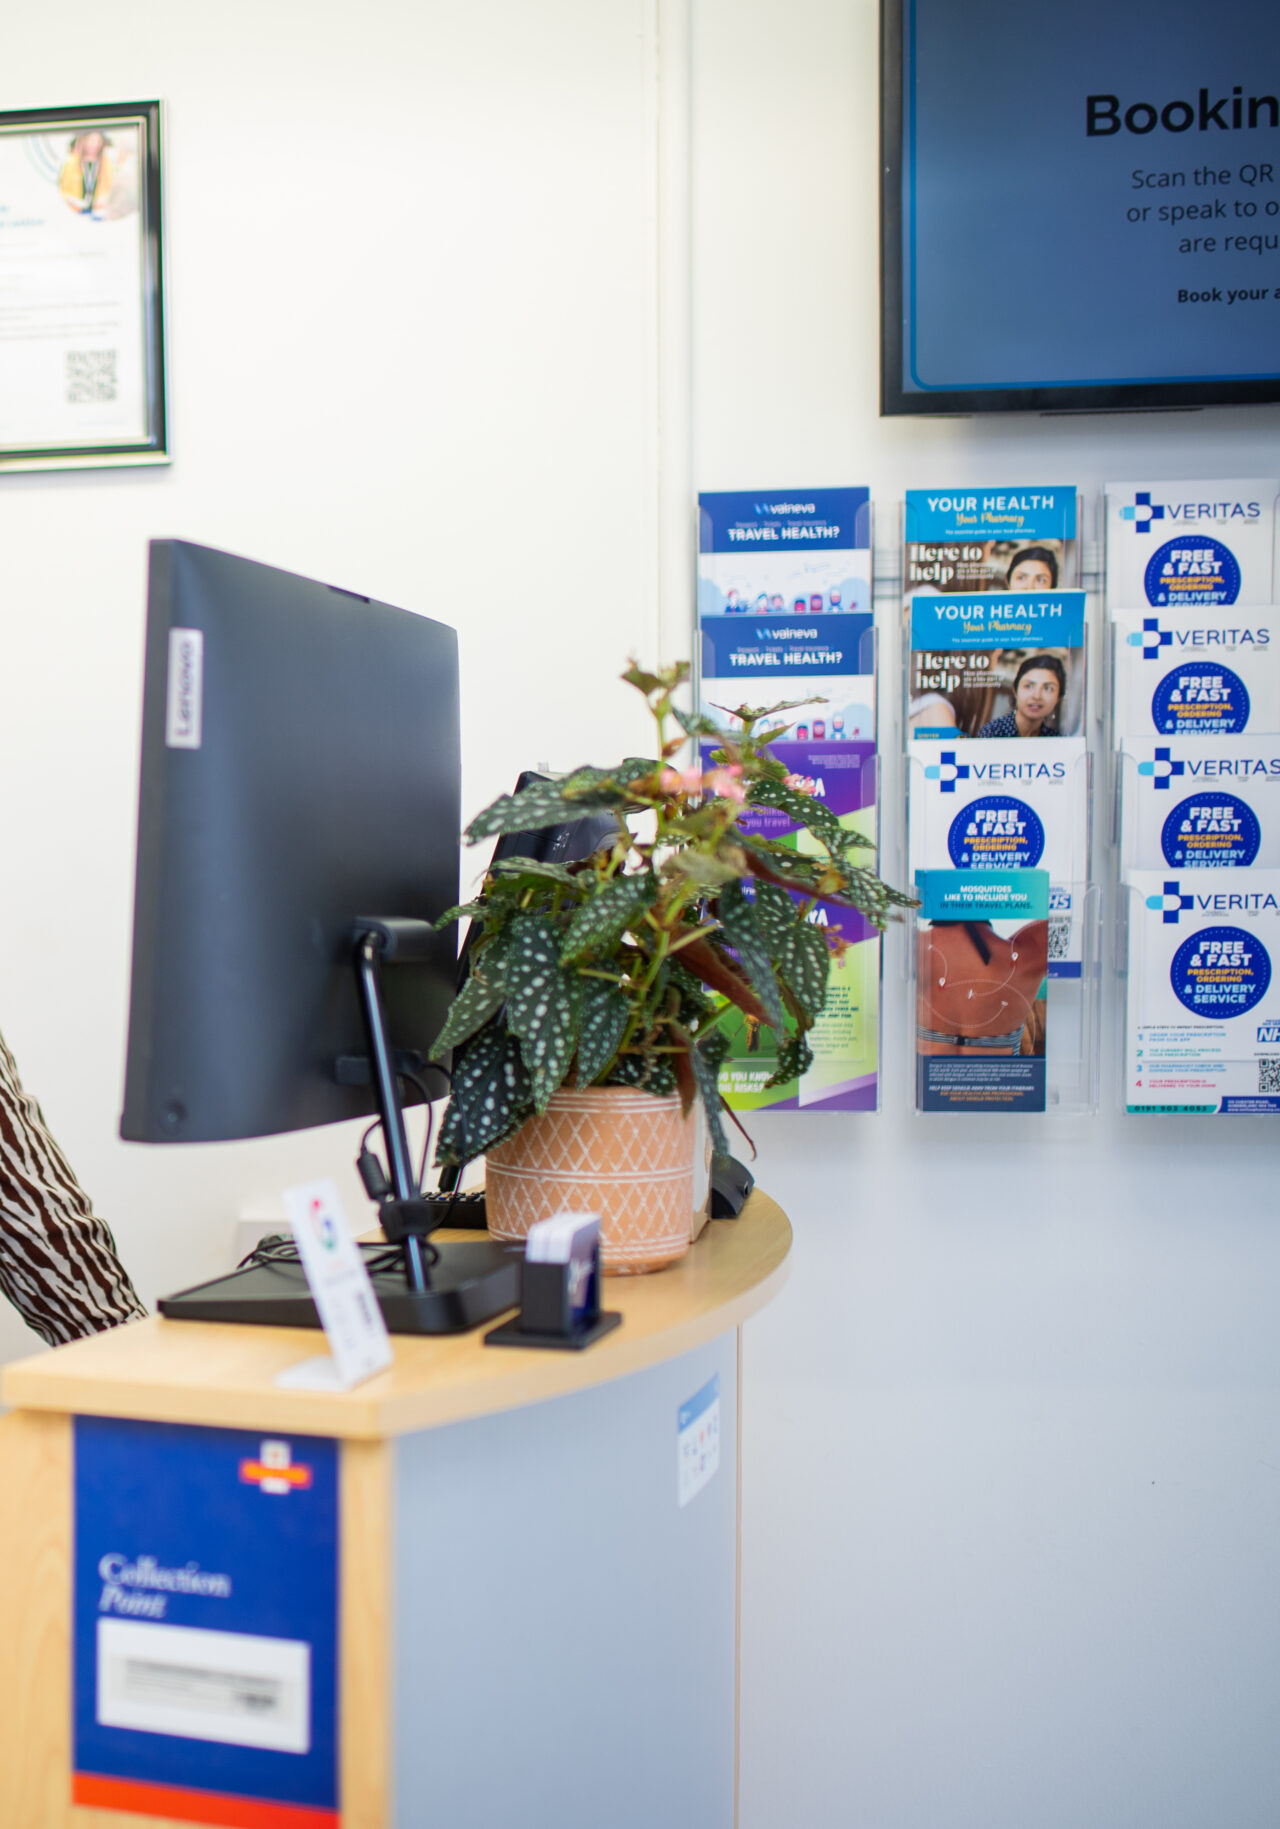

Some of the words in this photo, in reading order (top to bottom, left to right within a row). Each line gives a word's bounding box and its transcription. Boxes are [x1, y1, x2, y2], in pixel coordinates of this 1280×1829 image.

[1086, 86, 1280, 136] Bookin
[1131, 169, 1186, 189] Scan
[1194, 165, 1232, 186] the
[1239, 163, 1275, 188] QR
[1127, 207, 1152, 223] or
[1158, 199, 1226, 226] speak
[1234, 200, 1257, 218] to
[1178, 237, 1218, 254] are
[1224, 234, 1279, 256] requ
[1177, 288, 1222, 304] Book
[1227, 289, 1269, 306] your
[770, 502, 816, 515] valneva
[928, 497, 977, 512] YOUR
[983, 495, 1054, 511] HEALTH
[1167, 502, 1262, 519] VERITAS
[728, 527, 780, 542] TRAVEL
[782, 525, 841, 541] HEALTH?
[910, 545, 960, 562] Here
[962, 545, 983, 562] to
[1171, 549, 1215, 563] FREE
[909, 563, 954, 584] help
[1162, 562, 1175, 576] &
[1178, 561, 1223, 576] FAST
[1168, 591, 1228, 602] DELIVERY
[934, 605, 984, 620] YOUR
[990, 603, 1063, 619] HEALTH
[772, 627, 818, 640] valneva
[1176, 628, 1271, 646] VERITAS
[729, 653, 781, 667] TRAVEL
[784, 650, 843, 666] HEALTH?
[916, 653, 967, 670] Here
[969, 653, 990, 670] to
[915, 671, 961, 693] help
[1179, 676, 1223, 690] FREE
[1170, 689, 1182, 702] &
[1186, 688, 1231, 702] FAST
[1176, 718, 1236, 729] DELIVERY
[972, 762, 1066, 779] VERITAS
[1187, 758, 1280, 776] VERITAS
[975, 809, 1018, 824] FREE
[1190, 806, 1234, 820] FREE
[966, 822, 978, 836] &
[982, 821, 1027, 836] FAST
[1180, 819, 1192, 833] &
[1196, 818, 1242, 832] FAST
[1186, 841, 1232, 849] ORDERING
[972, 851, 1031, 862] DELIVERY
[1174, 850, 1183, 860] &
[1185, 849, 1246, 860] DELIVERY
[960, 884, 1012, 893] MOSQUITOES
[944, 893, 962, 902] LIKE
[963, 893, 974, 902] TO
[975, 893, 1009, 902] INCLUDE
[1010, 892, 1028, 902] YOU
[1048, 894, 1070, 909] HS
[1197, 893, 1278, 910] VERITA
[940, 902, 948, 910] IN
[950, 902, 972, 910] THEIR
[974, 902, 1003, 910] TRAVEL
[1199, 941, 1245, 955] FREE
[1190, 954, 1202, 967] &
[1206, 953, 1253, 967] FAST
[1196, 975, 1242, 983] ORDERING
[1184, 984, 1193, 994] &
[1195, 983, 1256, 994] DELIVERY
[1193, 993, 1247, 1004] SERVICE
[1136, 1049, 1144, 1058] 2
[731, 1071, 748, 1081] YOU
[1135, 1080, 1143, 1088] 4
[98, 1552, 232, 1599] Collection
[98, 1583, 167, 1619] Point
